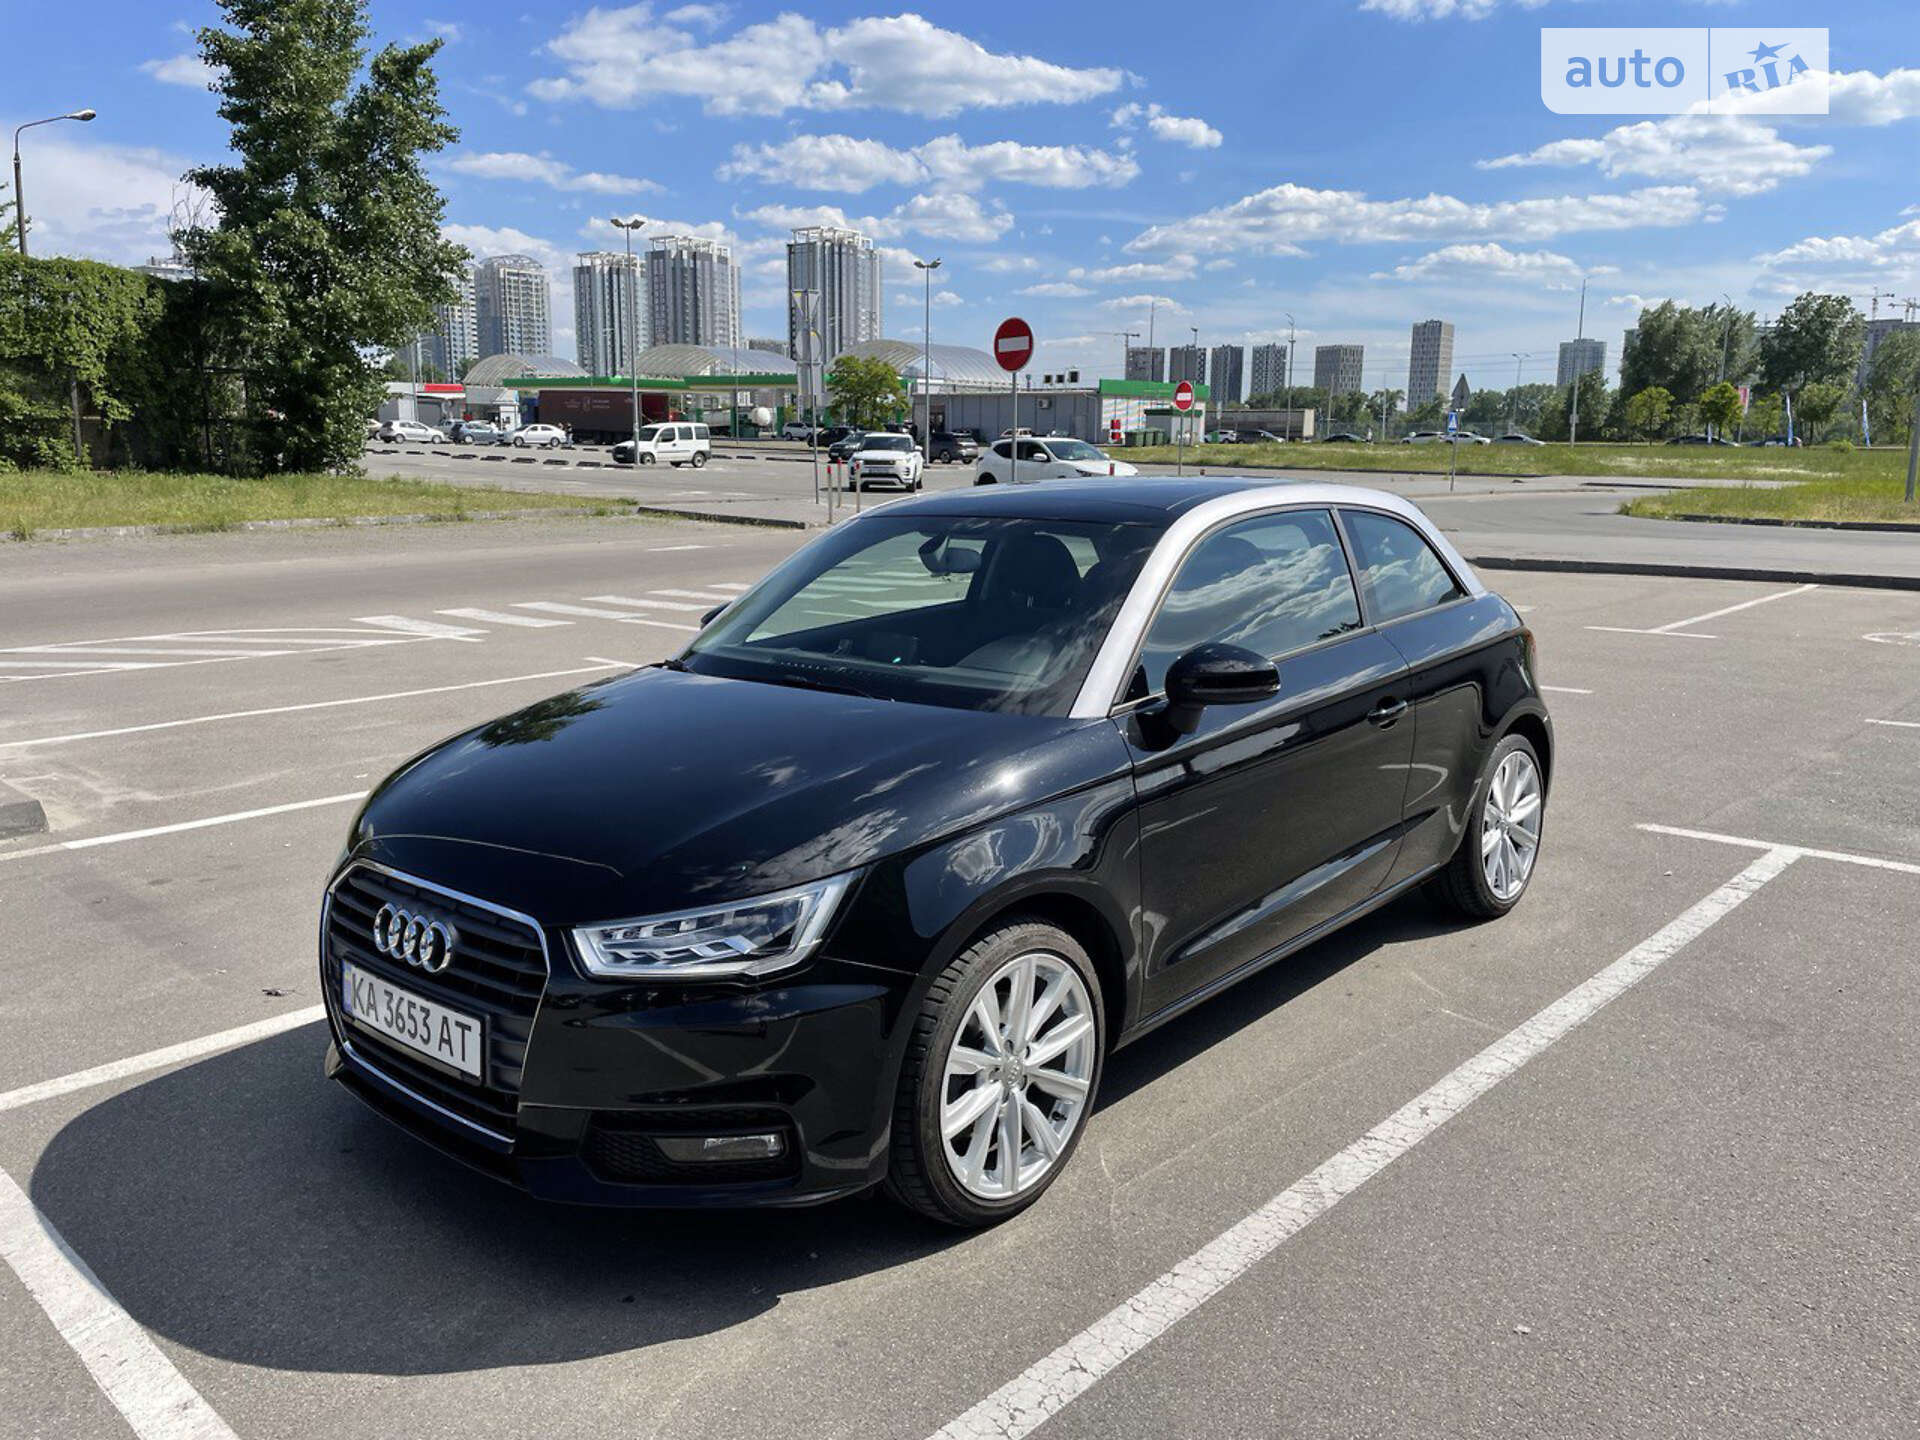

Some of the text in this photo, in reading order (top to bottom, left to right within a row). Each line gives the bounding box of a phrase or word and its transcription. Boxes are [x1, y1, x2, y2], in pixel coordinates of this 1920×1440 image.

[352, 973, 472, 1062] KA 3653 AT
